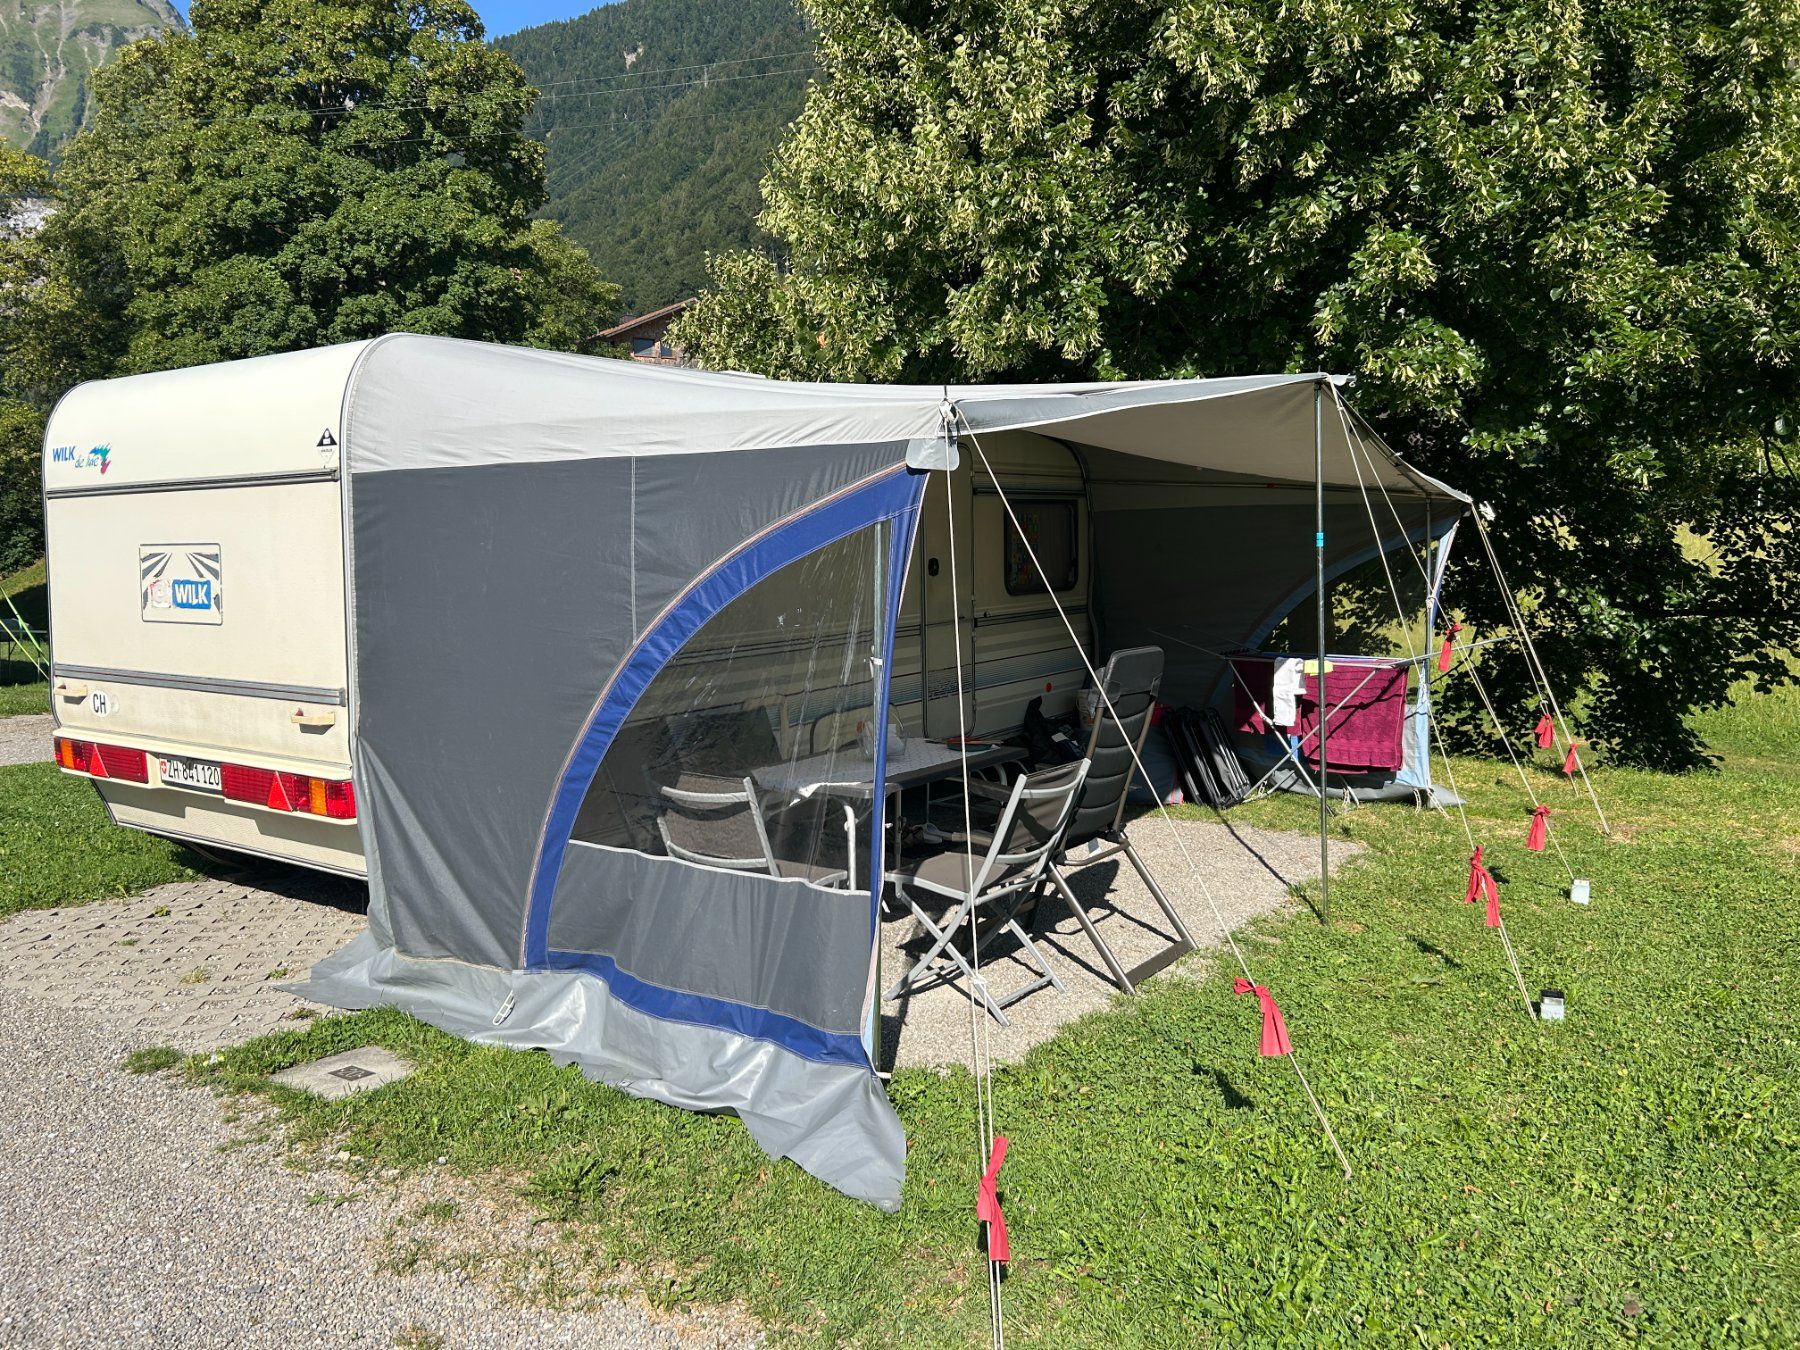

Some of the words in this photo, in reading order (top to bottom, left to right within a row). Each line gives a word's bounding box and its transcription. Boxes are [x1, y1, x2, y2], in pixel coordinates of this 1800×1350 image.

[52, 446, 76, 462] WILK
[174, 583, 209, 605] WILK
[93, 693, 106, 714] CH
